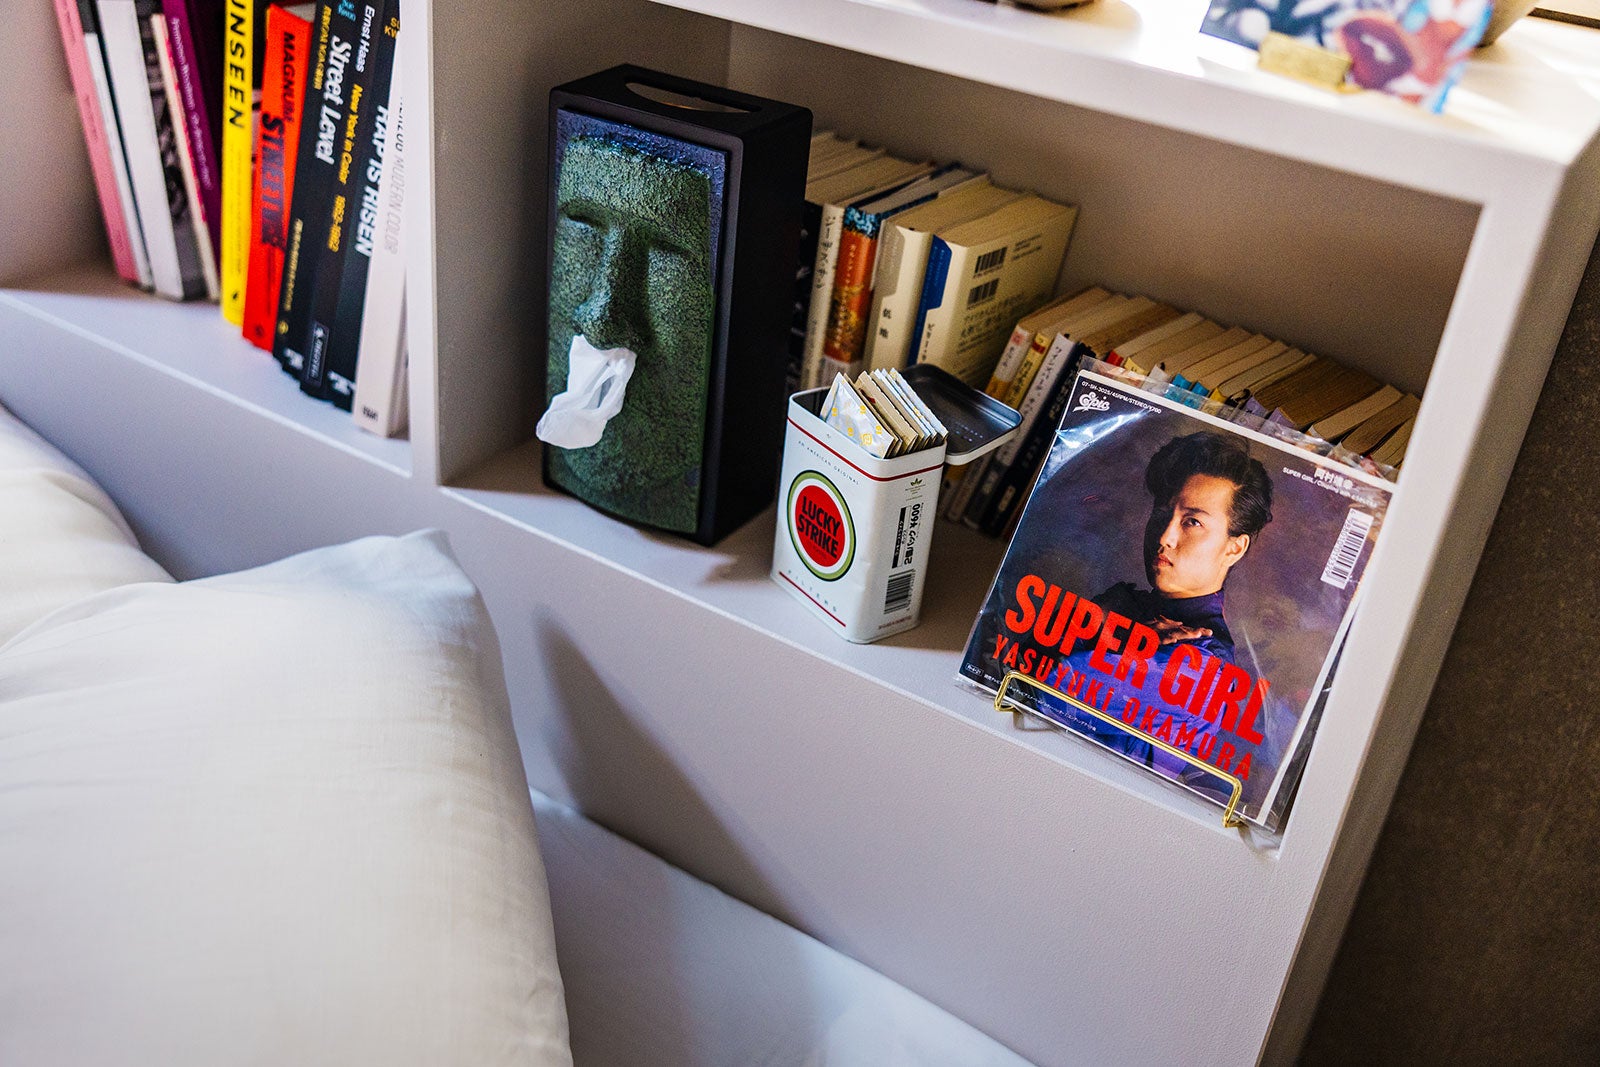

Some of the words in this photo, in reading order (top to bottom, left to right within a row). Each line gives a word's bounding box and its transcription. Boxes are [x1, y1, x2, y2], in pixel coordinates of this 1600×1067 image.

[361, 4, 376, 41] Ernst
[325, 35, 352, 106] Street
[356, 39, 371, 73] Haas
[351, 83, 363, 112] New
[315, 104, 342, 166] Level
[345, 111, 358, 139] York
[338, 150, 352, 185] Color
[354, 184, 381, 259] RISEN
[1072, 391, 1111, 413] Epic
[1282, 466, 1301, 478] SUPER
[801, 496, 841, 537] LUCKY
[797, 515, 839, 560] STRIKE
[1005, 574, 1161, 690] SUPER
[1158, 643, 1271, 746] GIRL
[991, 633, 1115, 713] YASUYUKI
[1121, 697, 1254, 781] OKAMURA
